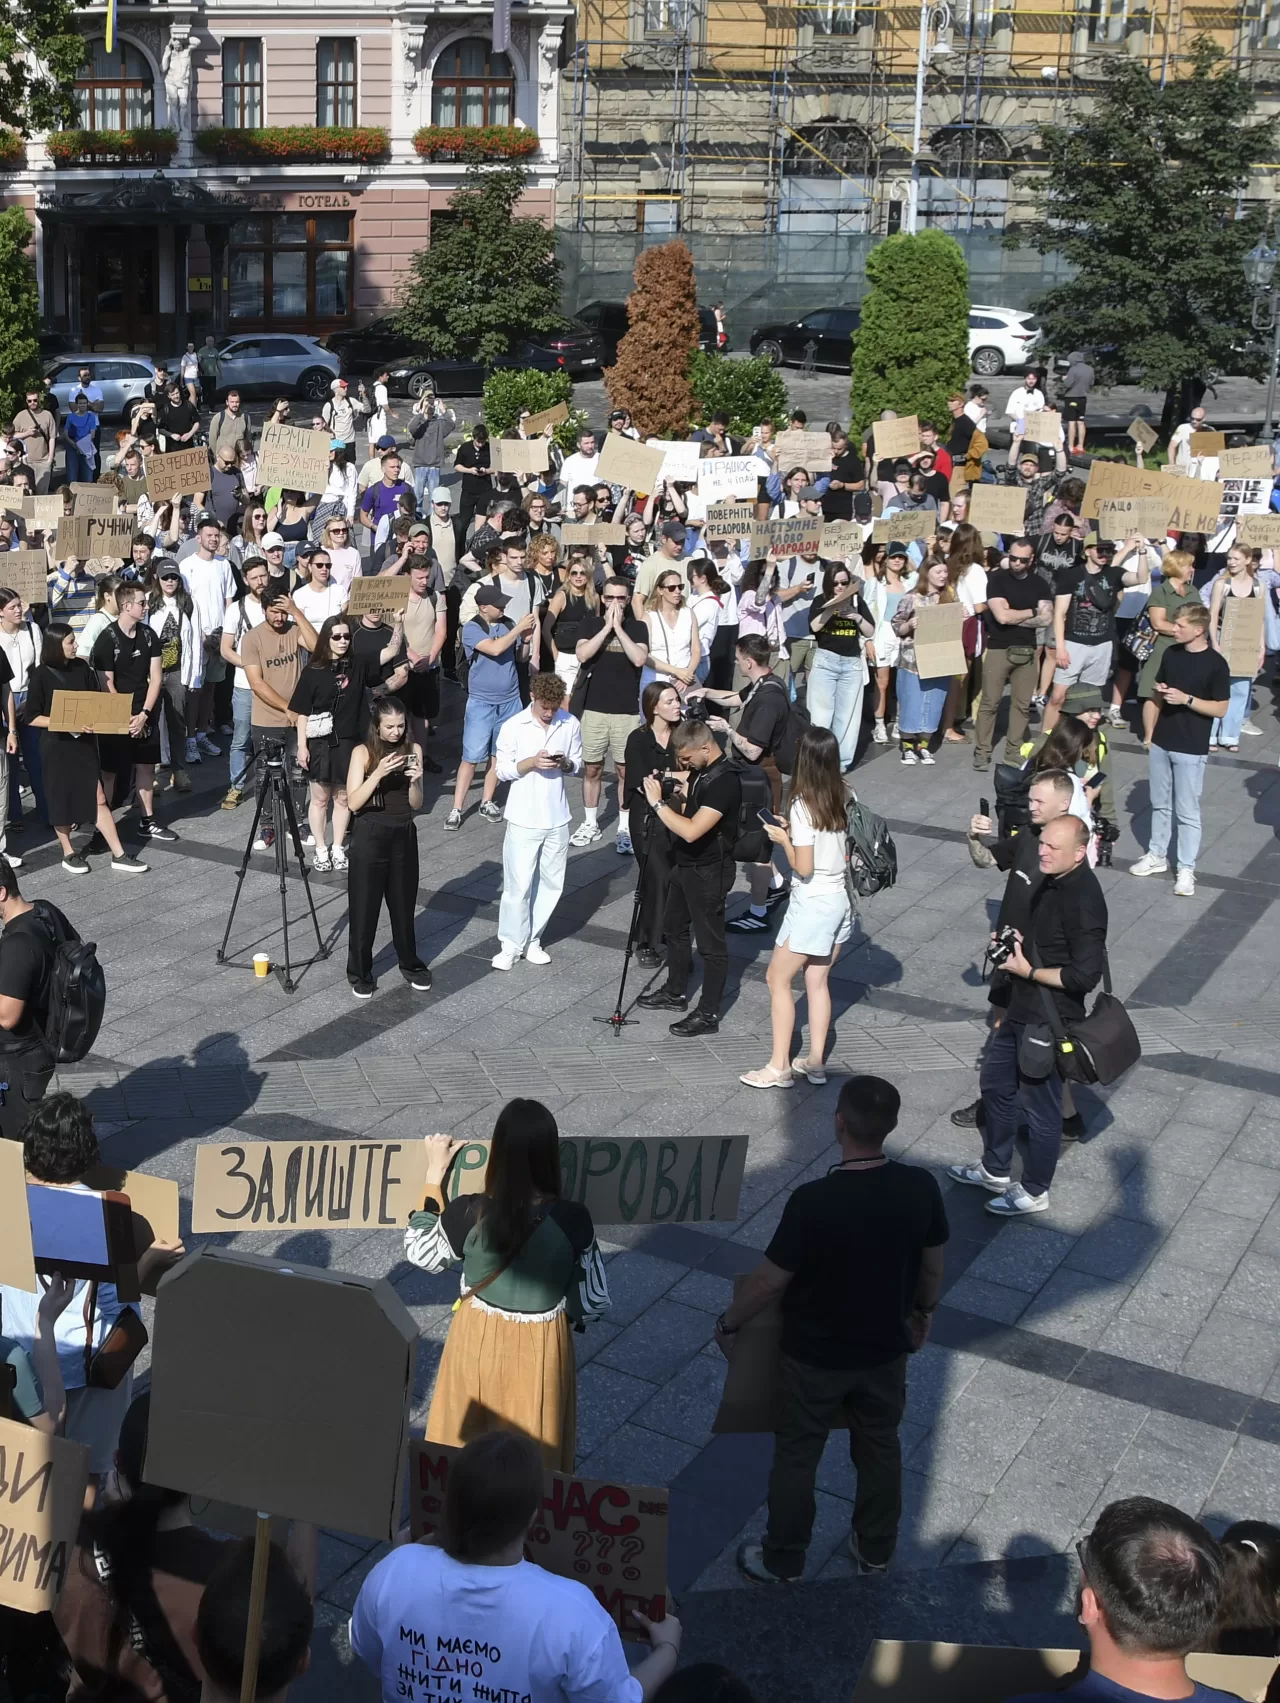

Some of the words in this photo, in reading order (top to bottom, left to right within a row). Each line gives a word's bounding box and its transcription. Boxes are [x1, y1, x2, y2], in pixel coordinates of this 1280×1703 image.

[297, 193, 351, 208] ГОТЕЛЬ
[265, 425, 312, 449] АРМІЇ
[147, 460, 167, 476] БЕЗ
[167, 450, 208, 472] ФЕДОРОВА
[154, 474, 177, 493] БУДЕ
[267, 475, 317, 489] КАНДИДАТ
[1103, 500, 1133, 513] НАЩО
[708, 521, 752, 536] ФЕДОРОВА
[756, 519, 818, 536] НАСТУПНЕ
[824, 525, 842, 535] БЕЗ
[770, 532, 804, 545] СЛОВО
[837, 532, 859, 542] НЬОГО
[64, 540, 131, 557] МІНІСТРАМ
[770, 540, 820, 555] НАРОДОМ
[266, 651, 299, 669] POHUY
[215, 1144, 403, 1226] ЗАЛИШТЕ
[399, 1625, 426, 1649] МИ
[436, 1633, 501, 1662] МАЄМО
[410, 1649, 483, 1678] ГІДНО
[397, 1662, 463, 1694] ЖИТИ
[395, 1682, 417, 1702] ЗА
